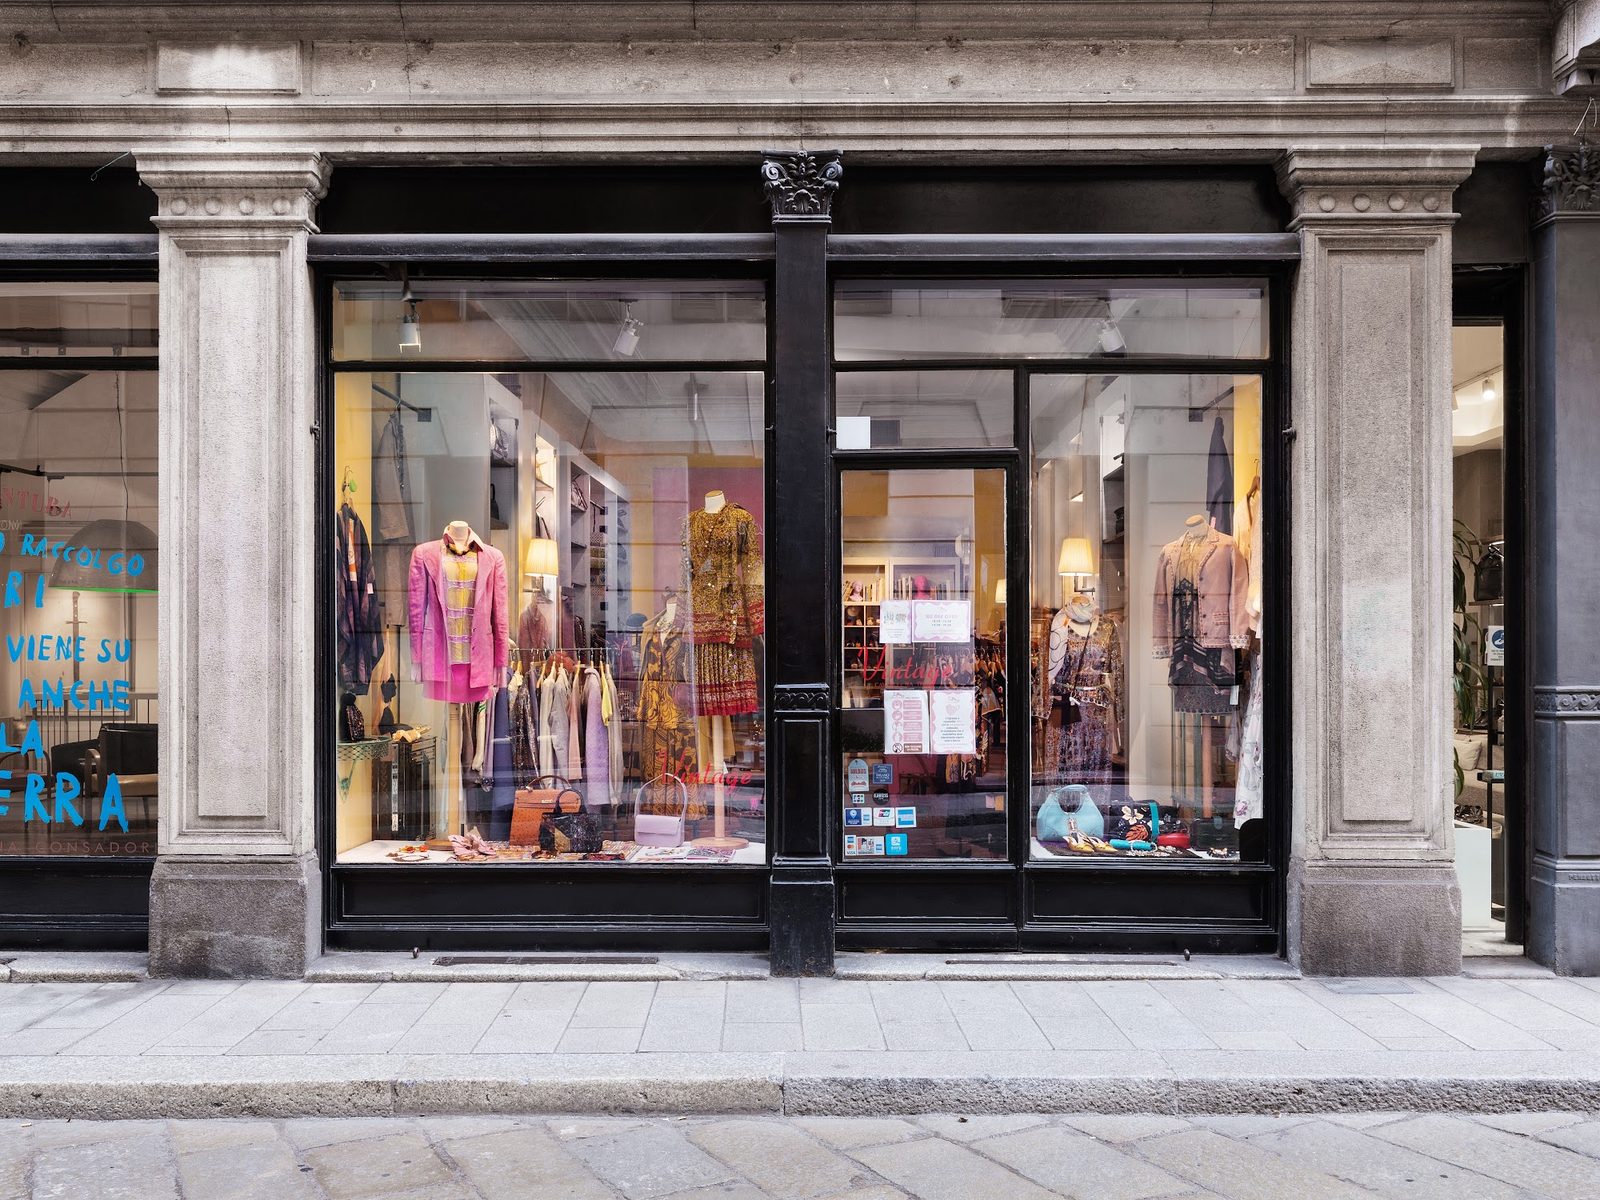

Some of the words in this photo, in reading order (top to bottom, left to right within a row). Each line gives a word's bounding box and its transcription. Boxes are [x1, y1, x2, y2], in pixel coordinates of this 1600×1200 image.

[21, 533, 145, 577] RACCOLGO
[6, 634, 87, 663] VIENE
[97, 639, 131, 663] SU
[857, 645, 954, 690] Vintage
[18, 678, 131, 711] ANCHE
[656, 748, 753, 794] Vintage
